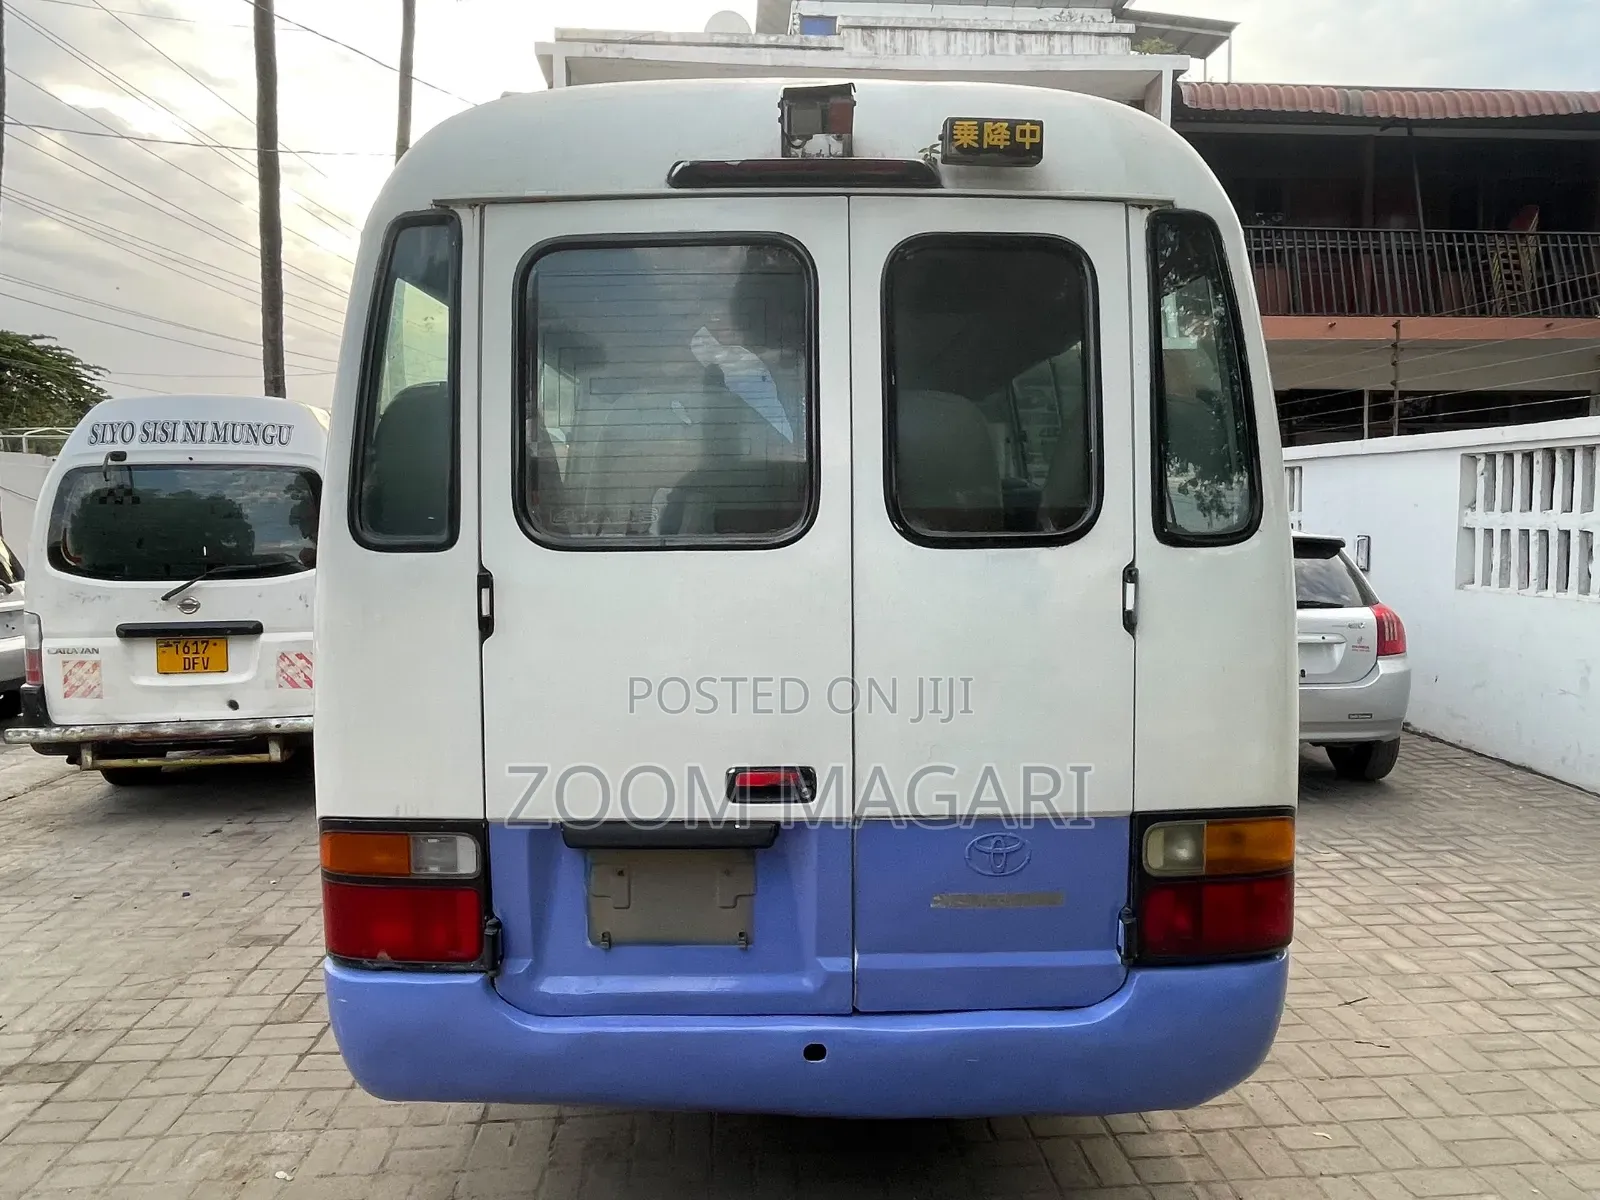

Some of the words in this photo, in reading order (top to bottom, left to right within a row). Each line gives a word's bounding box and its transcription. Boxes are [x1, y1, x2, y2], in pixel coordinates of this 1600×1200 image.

[952, 120, 1041, 150] 乗降中
[88, 421, 136, 446] SIYO
[139, 420, 180, 444] SISI
[181, 420, 208, 445] NI
[208, 421, 294, 447] MUNGU
[172, 640, 210, 655] T617
[183, 656, 210, 671] DFV
